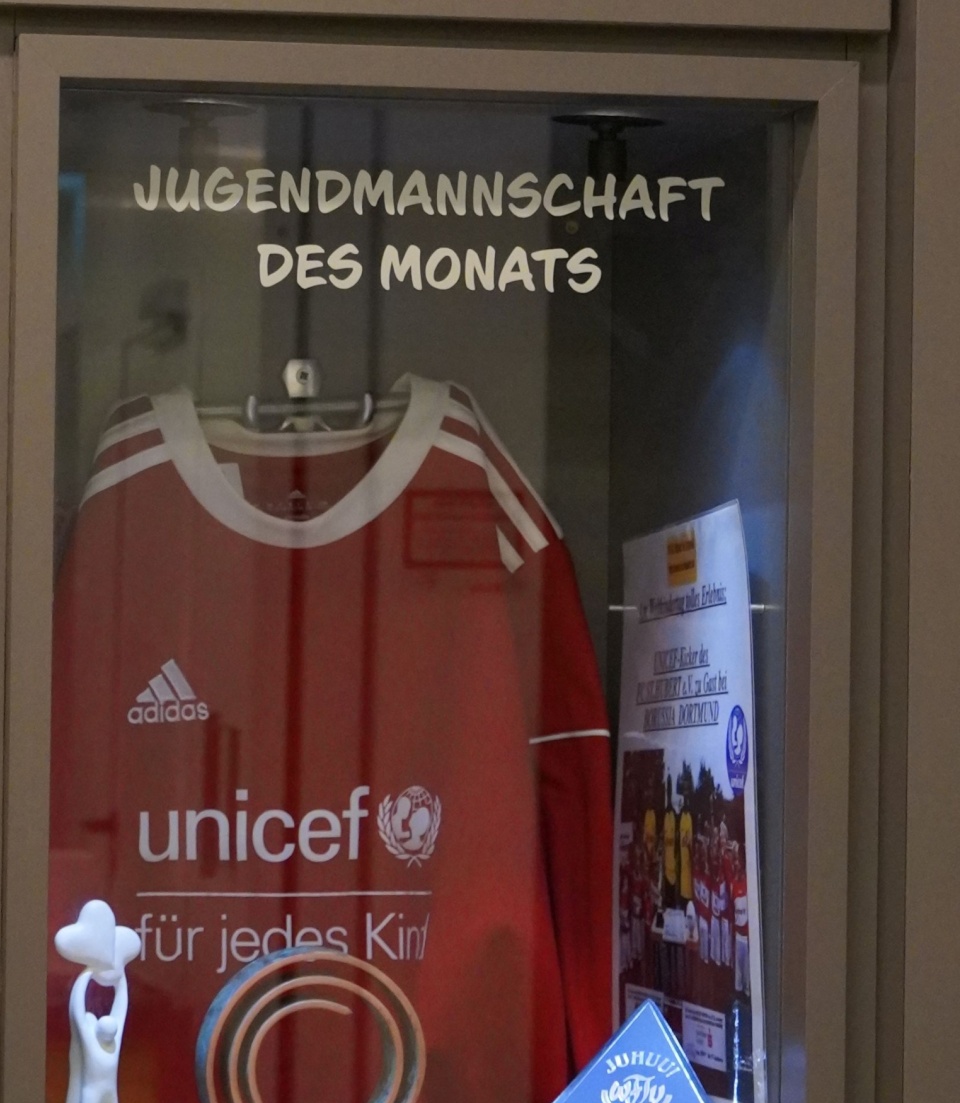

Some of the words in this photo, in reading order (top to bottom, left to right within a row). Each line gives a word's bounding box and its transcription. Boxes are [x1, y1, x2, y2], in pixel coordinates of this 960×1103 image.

[133, 165, 725, 221] JUGENDMANNSCHAFT
[257, 243, 363, 290] DES
[380, 244, 601, 293] MONATS
[127, 701, 209, 724] adidas
[678, 700, 720, 725] DORTMUND
[139, 785, 370, 863] unicef
[135, 914, 204, 962] für
[216, 914, 348, 973] jedes
[606, 1051, 681, 1079] JUHUU!
